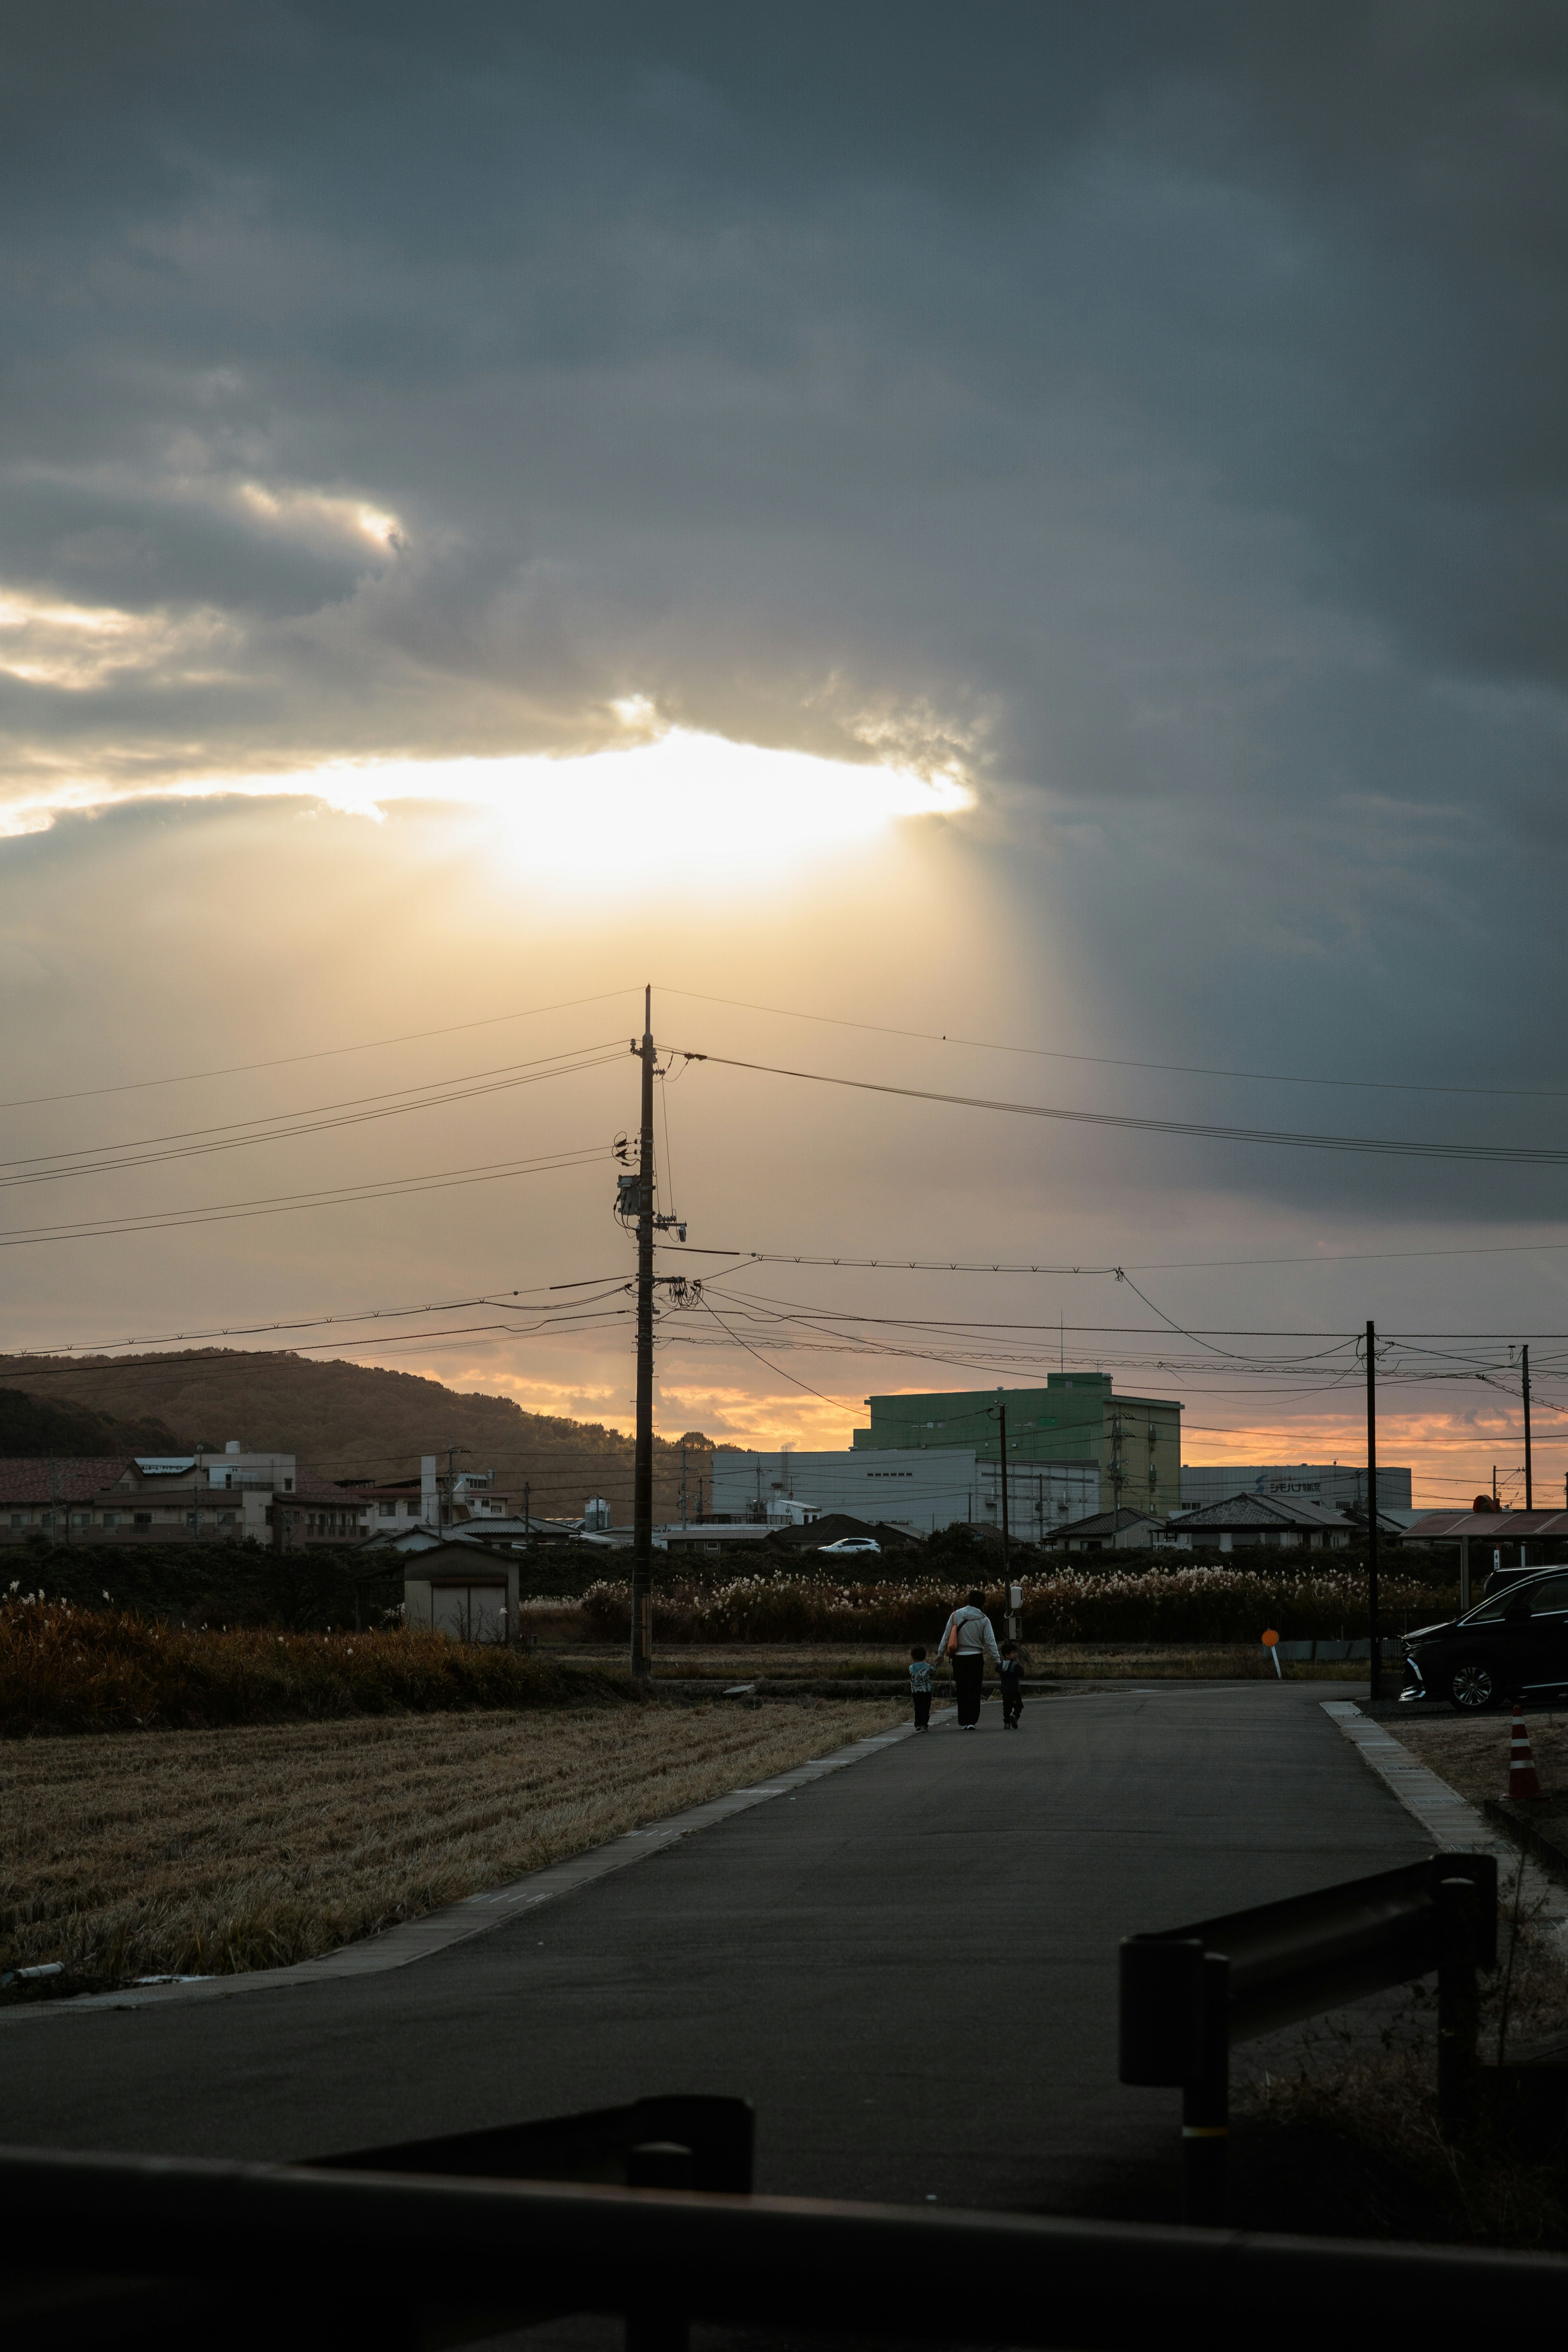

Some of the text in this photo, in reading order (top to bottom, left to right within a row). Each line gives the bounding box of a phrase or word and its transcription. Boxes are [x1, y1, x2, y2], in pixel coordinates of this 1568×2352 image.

[1270, 1483, 1320, 1493] シモハナ物流
